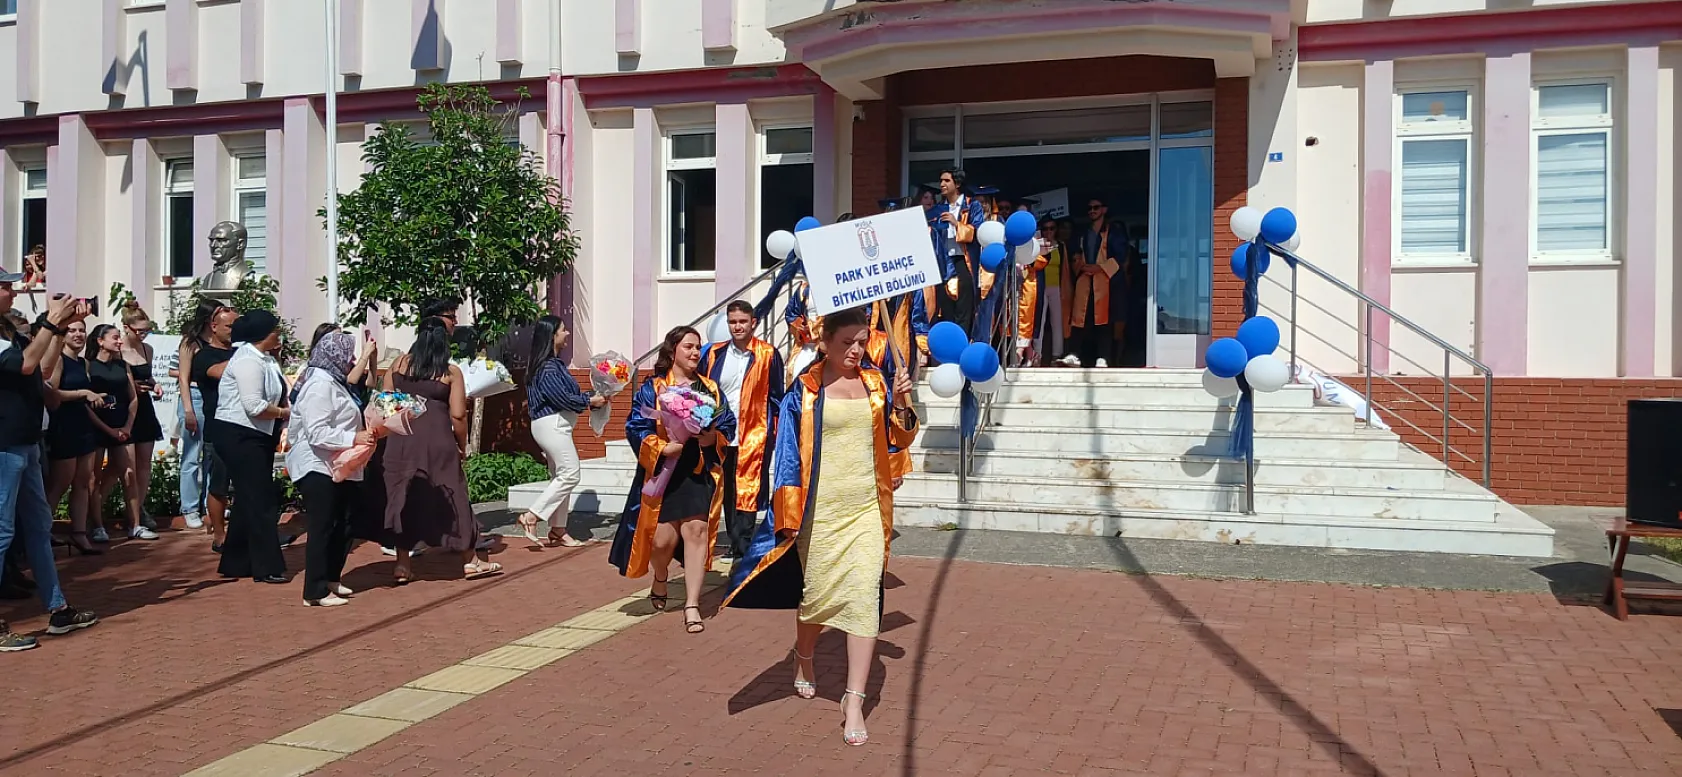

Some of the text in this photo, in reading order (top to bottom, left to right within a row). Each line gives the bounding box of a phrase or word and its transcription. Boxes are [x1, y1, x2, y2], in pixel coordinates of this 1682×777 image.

[835, 255, 914, 285] PARK VE BAHÇE
[832, 271, 925, 307] BİTKİLERİ BÖLÜMÜ
